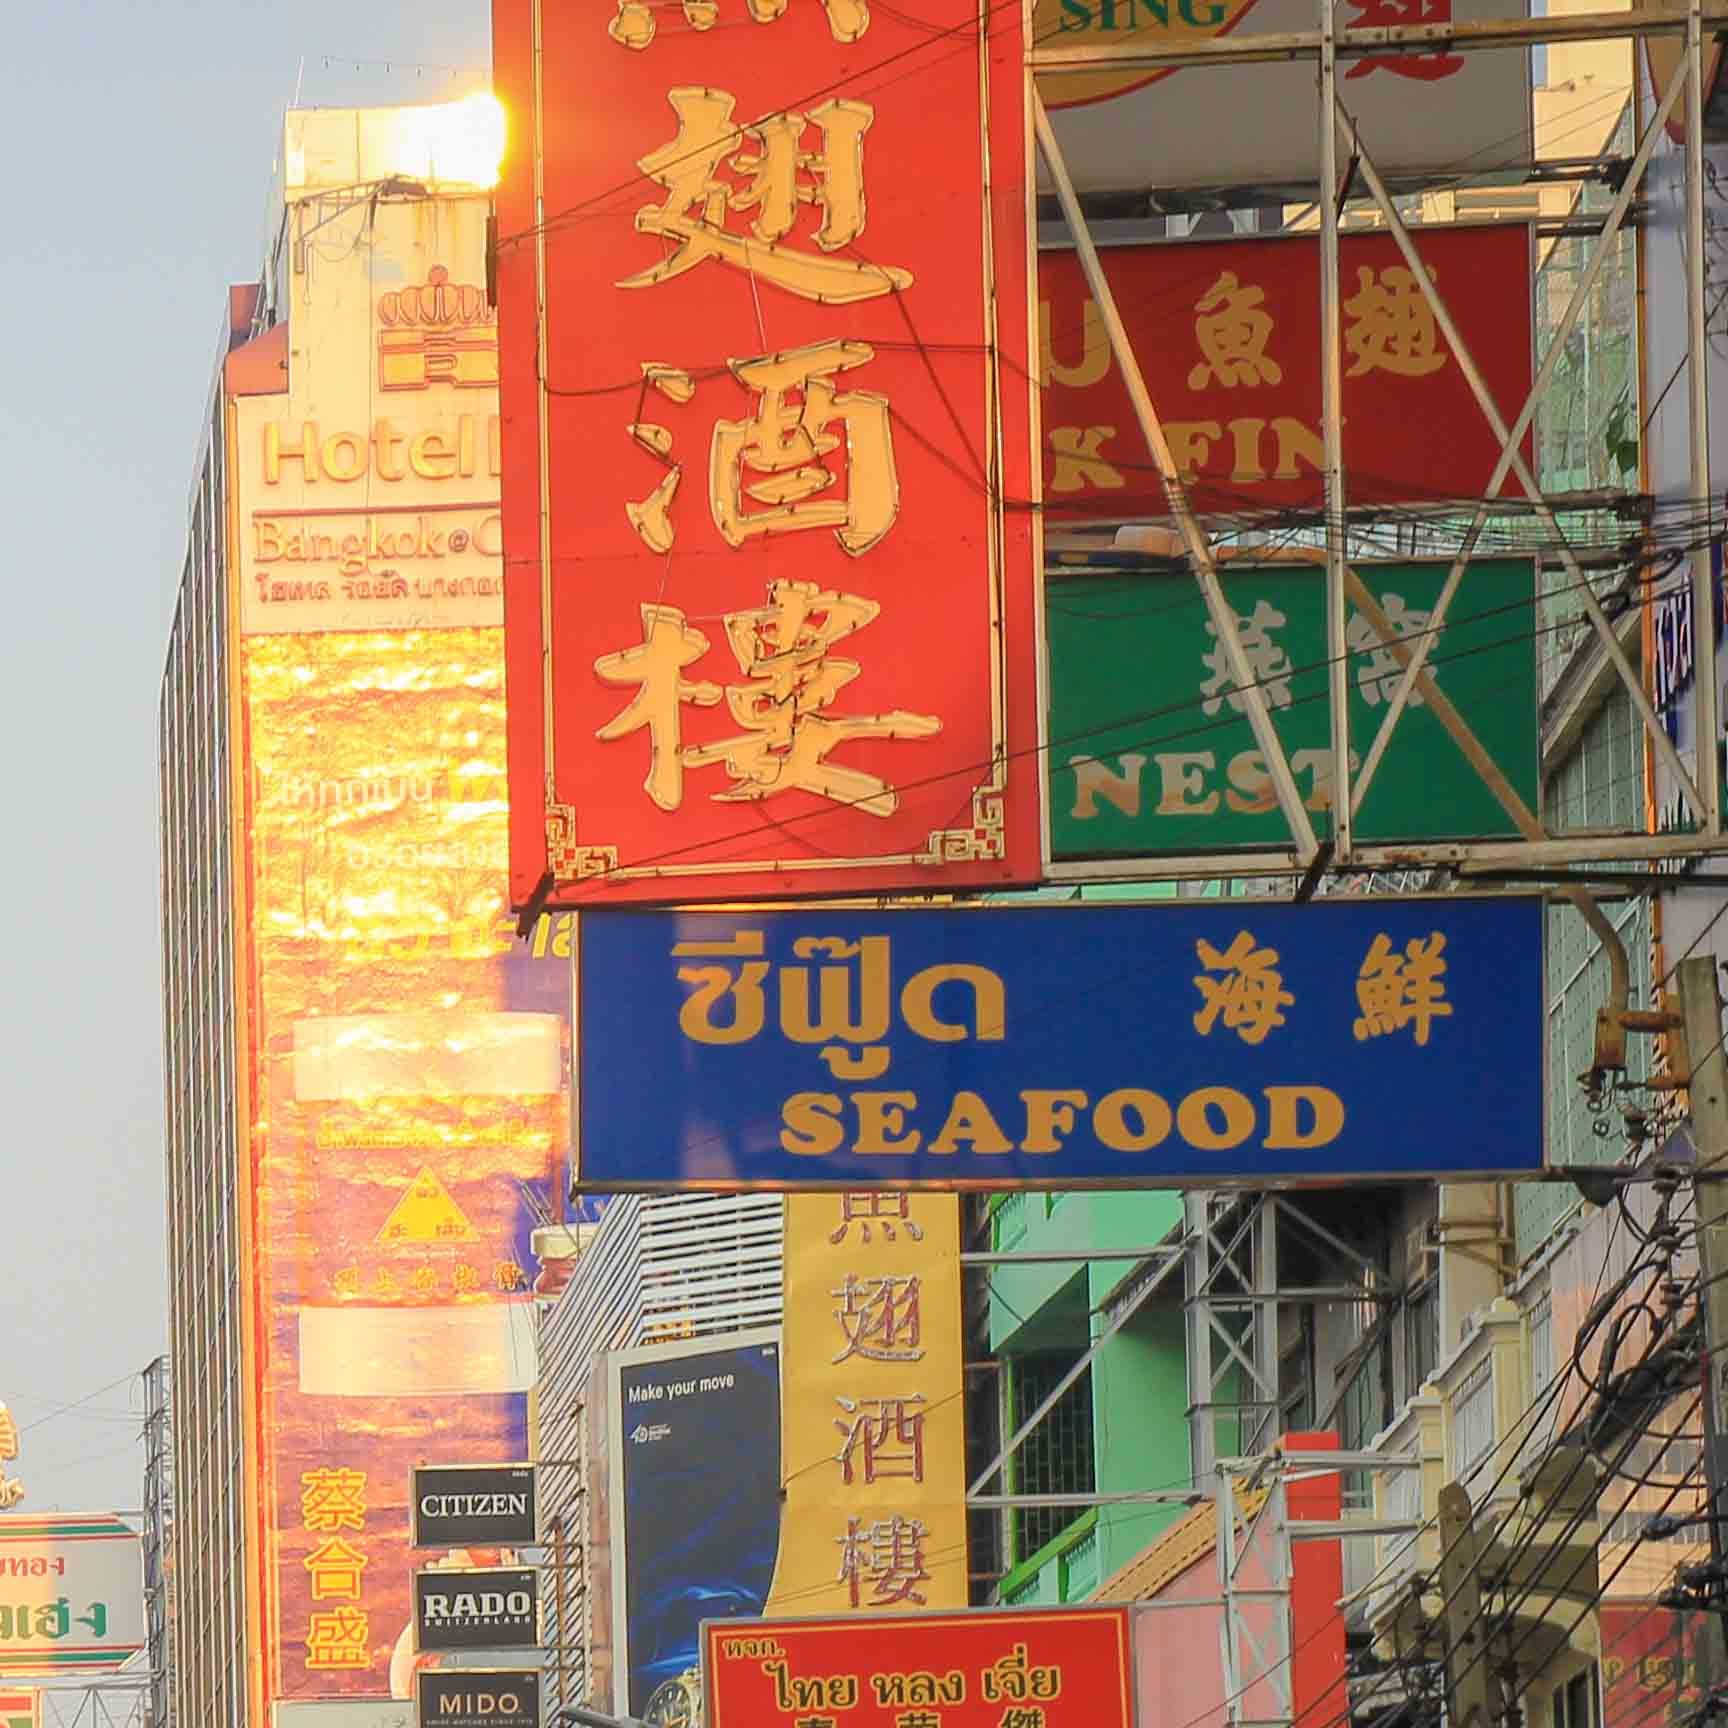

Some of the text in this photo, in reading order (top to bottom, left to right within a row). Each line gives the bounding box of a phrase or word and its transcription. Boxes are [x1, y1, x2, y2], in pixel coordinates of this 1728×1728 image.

[1186, 263, 1449, 391] 魚翅
[593, 0, 942, 820] 翅酒樓
[260, 413, 475, 484] Hotel
[253, 512, 452, 575] Bangkok
[1190, 930, 1454, 1048] 海鮮
[778, 1085, 1347, 1158] SEAFOOD
[629, 1374, 734, 1403] Make your move
[420, 1493, 528, 1518] CITIZEN
[301, 1467, 370, 1670] 蔡合盛
[424, 1591, 531, 1619] RADO
[439, 1693, 520, 1715] MIDO
[761, 1660, 858, 1711] ไทย
[870, 1669, 964, 1706] หลง
